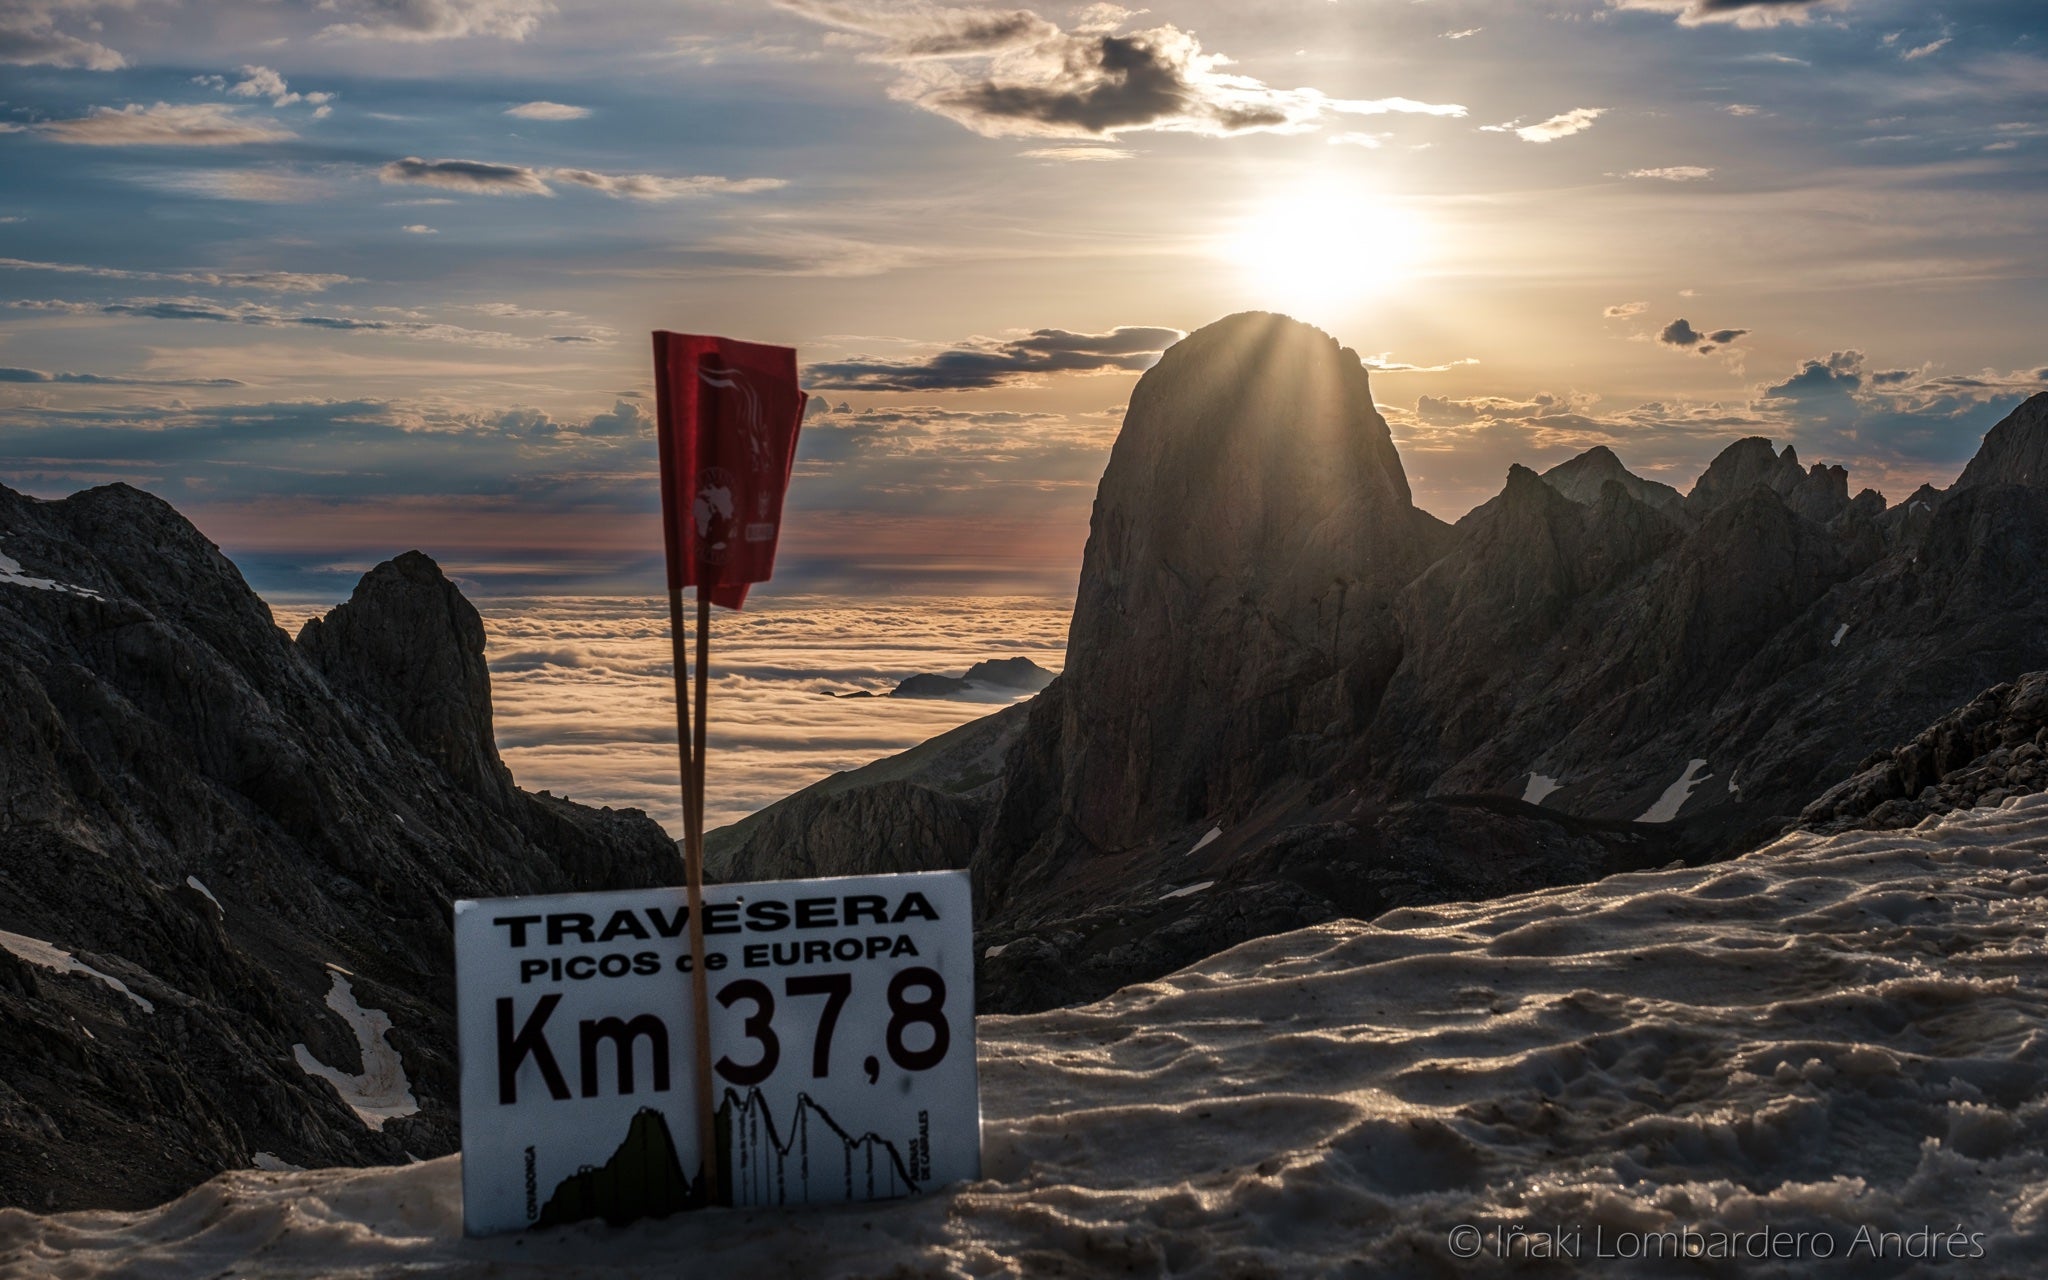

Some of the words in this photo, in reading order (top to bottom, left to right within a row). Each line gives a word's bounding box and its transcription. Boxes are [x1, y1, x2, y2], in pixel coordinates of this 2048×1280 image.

[493, 892, 940, 948] TRAVESERA
[520, 952, 661, 984] PICOS
[743, 935, 920, 969] EUROPA
[495, 993, 671, 1105] Km
[714, 967, 951, 1086] 37,8
[525, 1145, 537, 1220] COVADONGA
